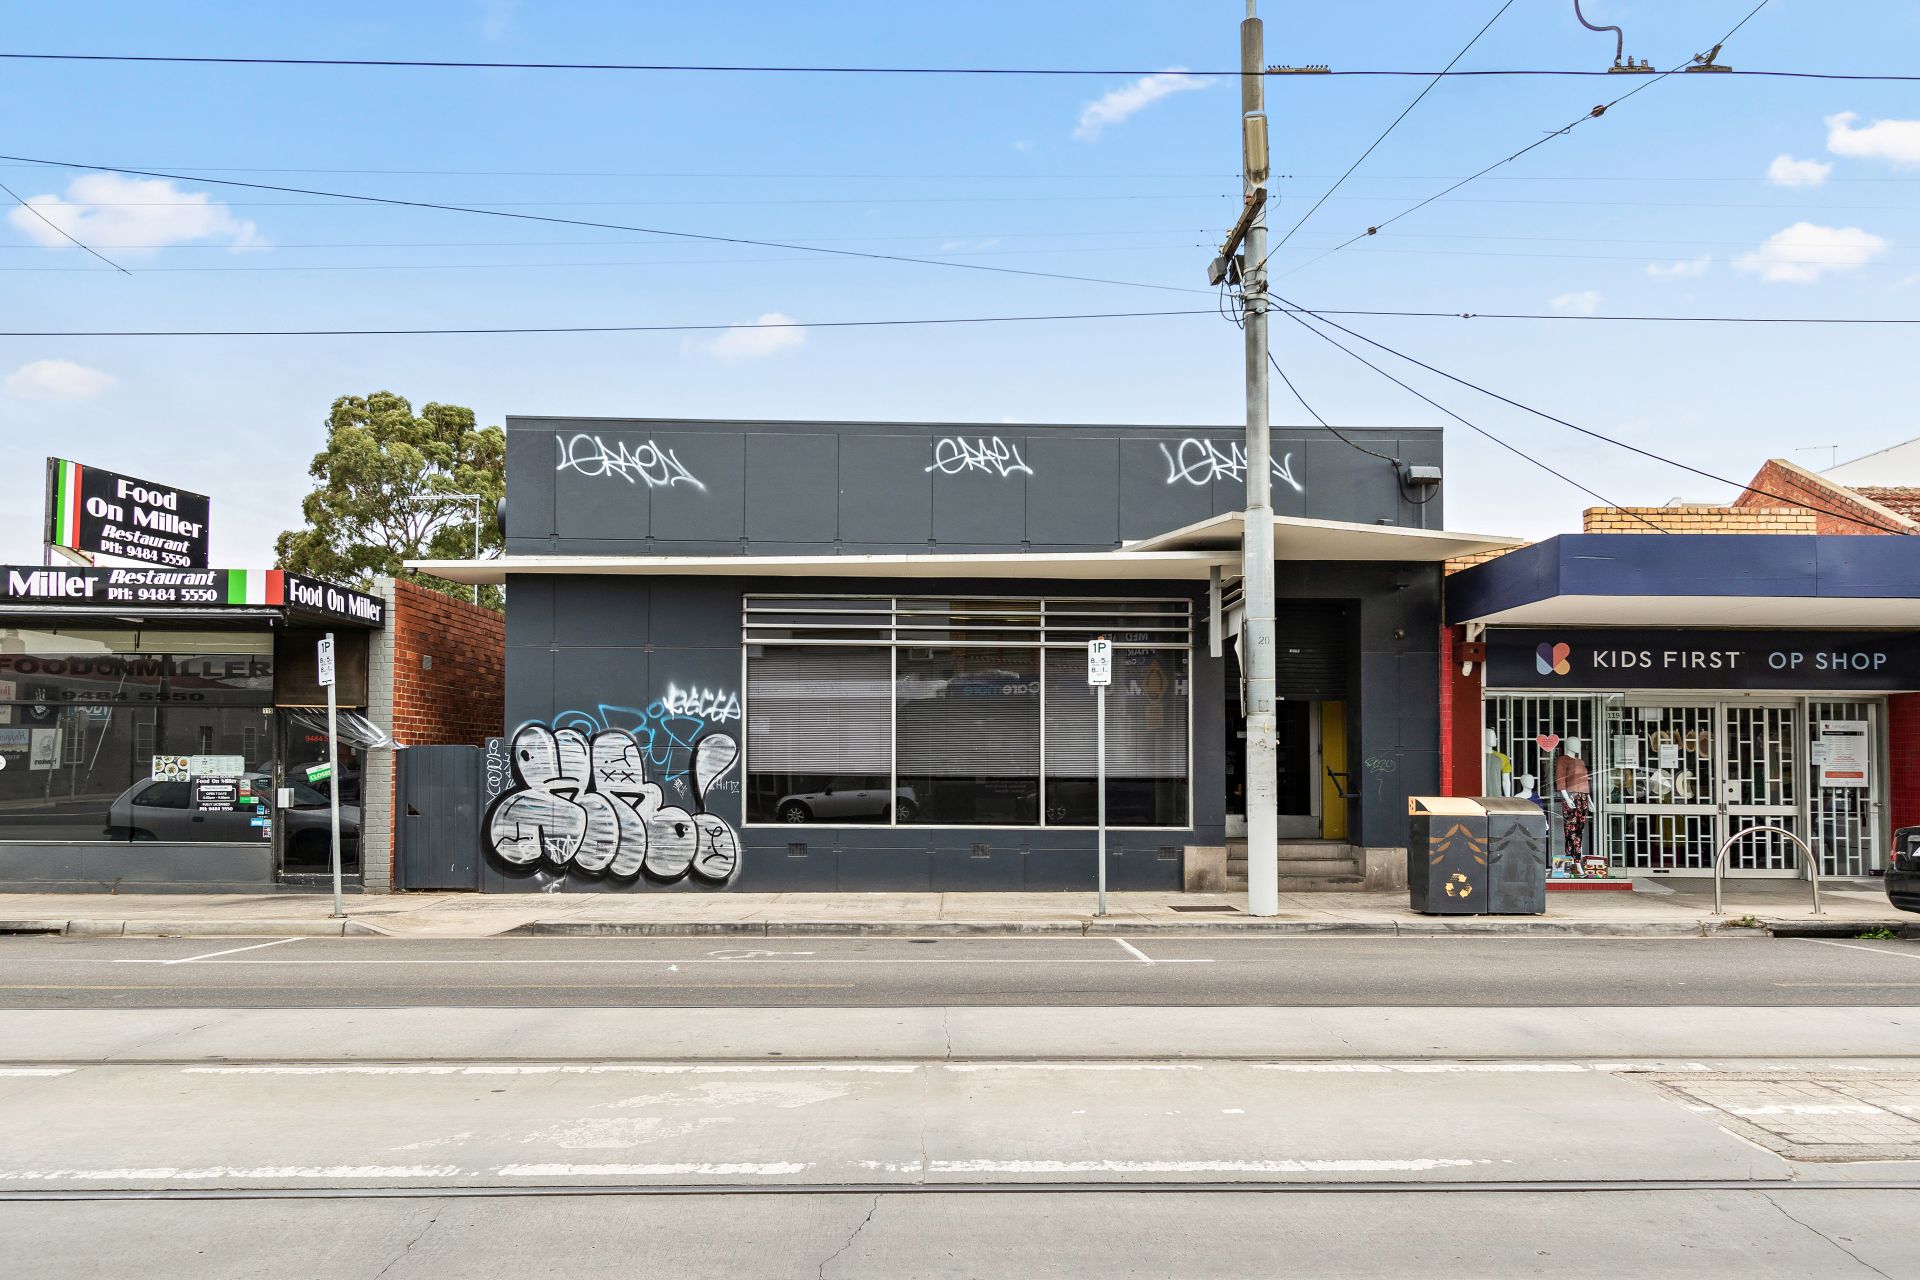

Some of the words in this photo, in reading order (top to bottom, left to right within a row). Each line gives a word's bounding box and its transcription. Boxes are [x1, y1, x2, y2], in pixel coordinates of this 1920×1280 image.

[117, 478, 177, 511] Food
[86, 496, 123, 522] On
[133, 506, 203, 538] Miller
[102, 524, 190, 553] Restaurant
[101, 540, 123, 555] PH:
[126, 545, 158, 561] 9484
[161, 551, 191, 567] 5550
[9, 570, 99, 597] Miller
[109, 569, 217, 586] Restaurant
[108, 588, 133, 600] PH:
[137, 588, 176, 601] 9484
[181, 588, 218, 601] 5550
[289, 578, 323, 608] Food
[327, 588, 345, 613] On
[348, 593, 382, 622] Miller
[1093, 642, 1107, 654] 1P
[1593, 650, 1652, 668] KIDS
[1663, 651, 1740, 669] FIRST
[1768, 652, 1804, 669] OP
[1815, 652, 1887, 670] SHOP
[142, 660, 274, 677] MILLER
